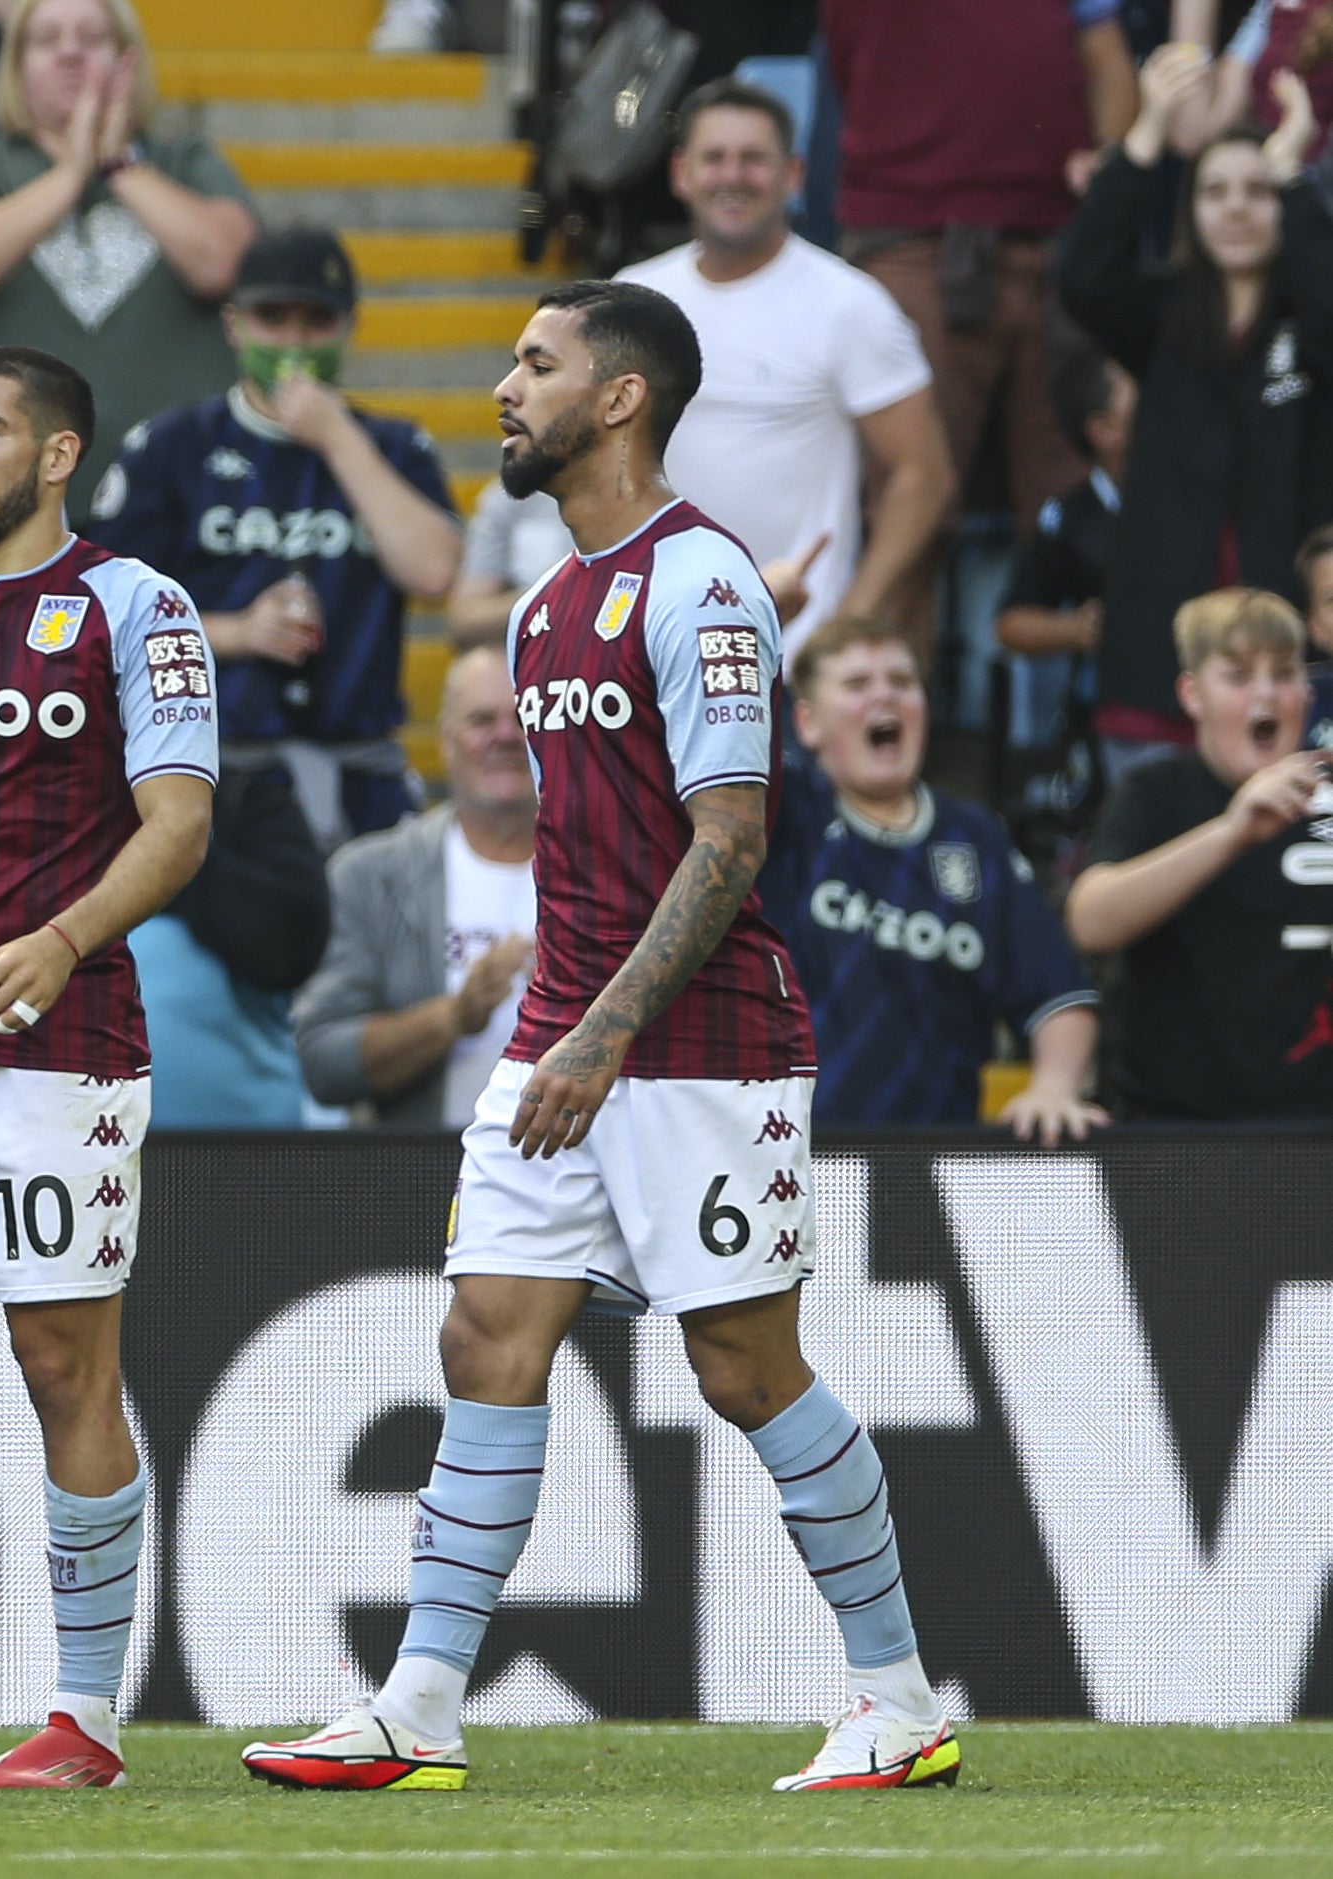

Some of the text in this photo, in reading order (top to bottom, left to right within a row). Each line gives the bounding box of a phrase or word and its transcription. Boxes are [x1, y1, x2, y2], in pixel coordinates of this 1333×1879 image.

[41, 600, 84, 611] AVFC
[145, 633, 205, 666] 欧宝
[699, 630, 758, 660] 欧宝
[152, 665, 209, 698] 体育
[704, 663, 759, 694] 体育
[514, 677, 633, 736] AZOO
[705, 703, 765, 726] OB.COM
[698, 1173, 751, 1258] 6
